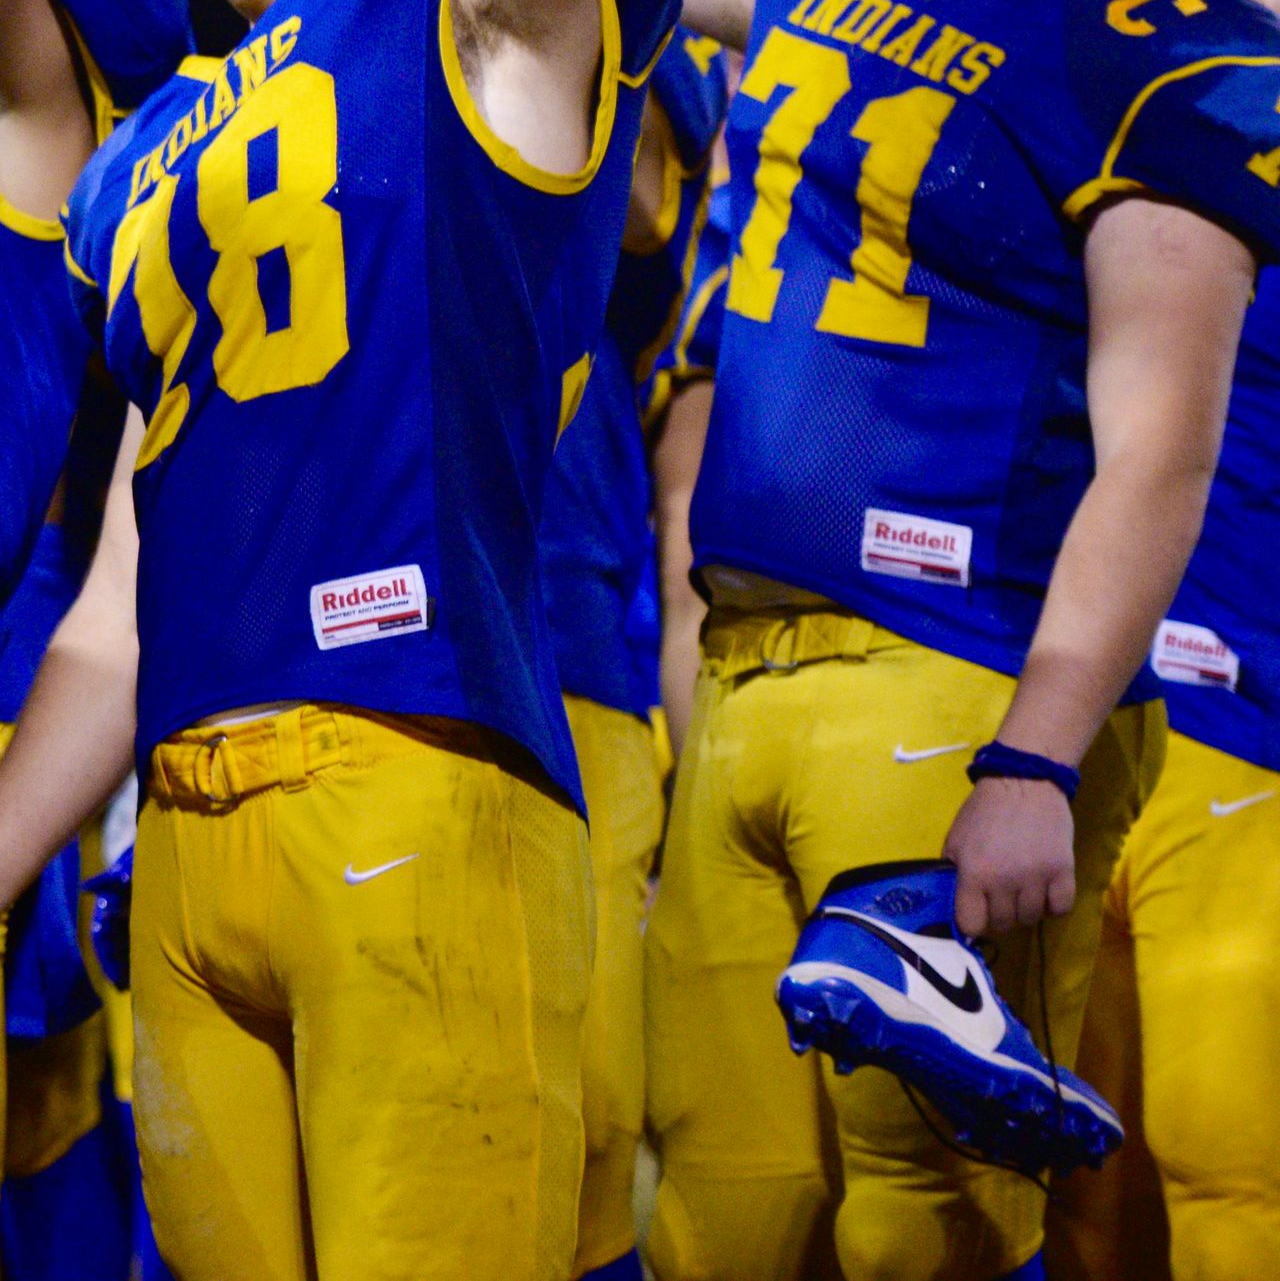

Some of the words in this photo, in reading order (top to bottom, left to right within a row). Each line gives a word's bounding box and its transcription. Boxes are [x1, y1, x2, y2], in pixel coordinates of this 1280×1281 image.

[726, 25, 956, 348] 71
[875, 521, 957, 552] Riddell
[321, 578, 408, 612] Riddell
